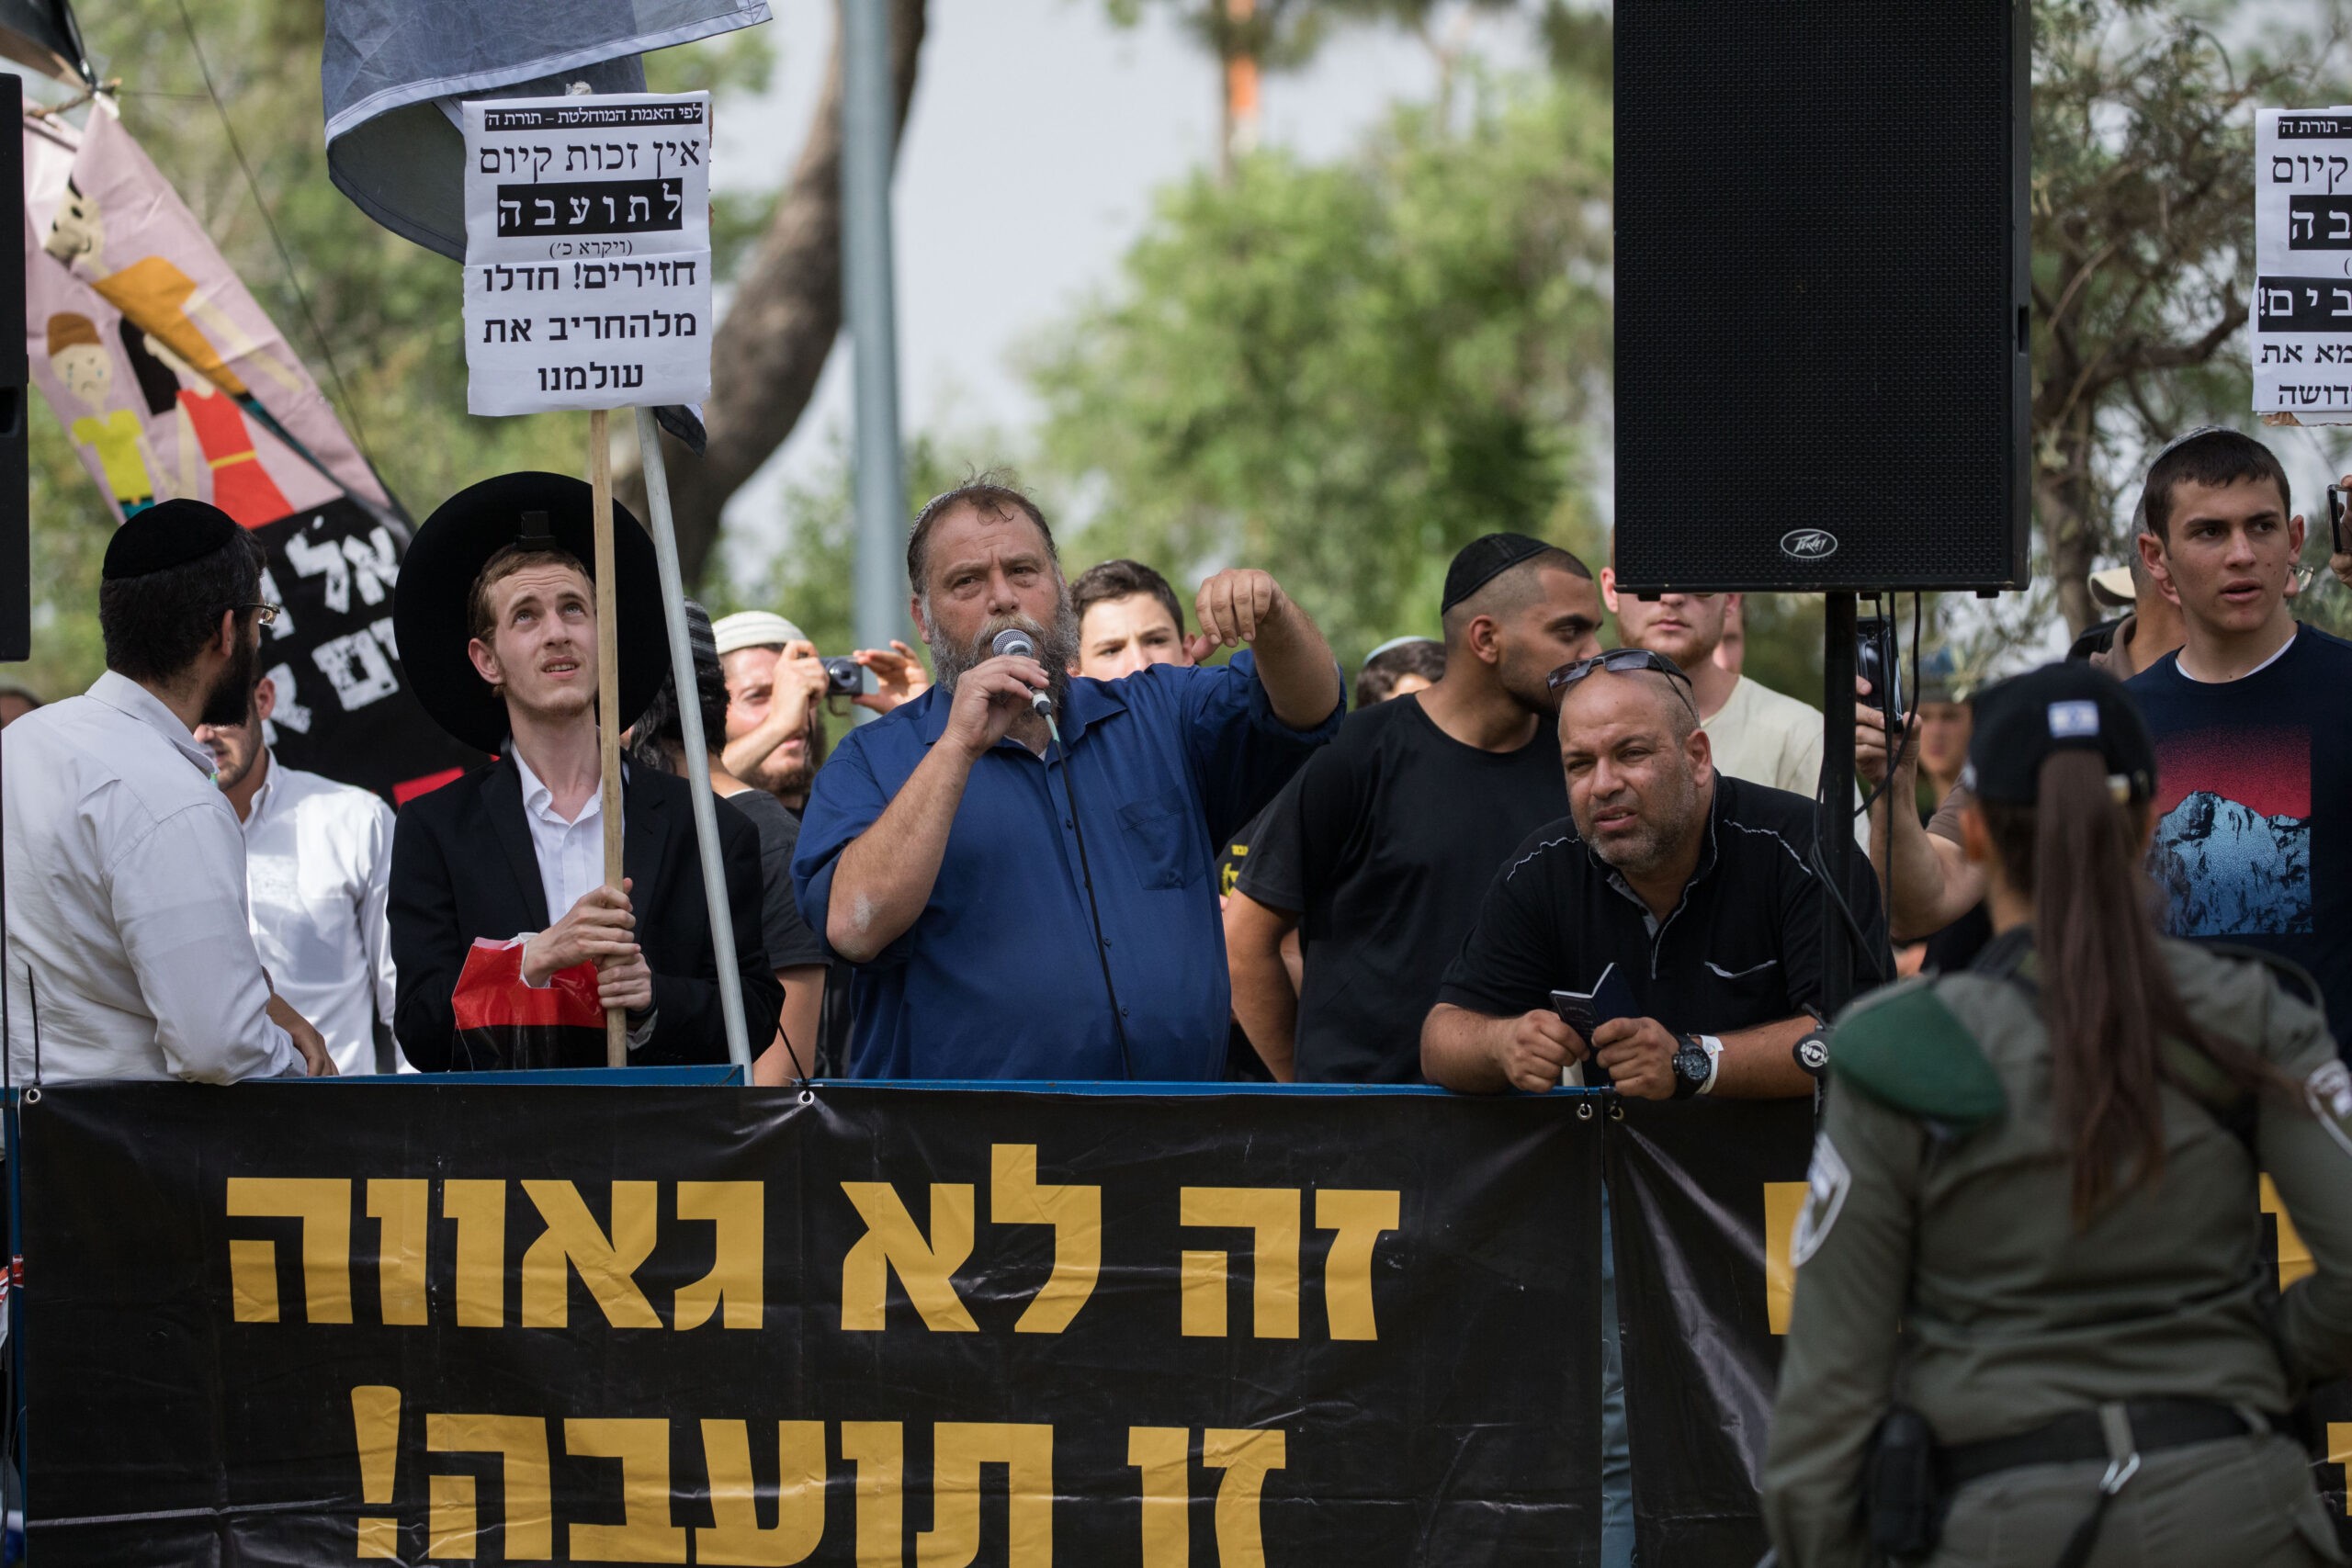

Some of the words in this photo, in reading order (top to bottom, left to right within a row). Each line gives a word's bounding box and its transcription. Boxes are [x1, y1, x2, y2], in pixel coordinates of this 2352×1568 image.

[503, 112, 542, 126] תורת
[558, 107, 627, 124] המוחלטת
[630, 108, 674, 122] האמת
[678, 103, 702, 118] לפי
[2298, 120, 2338, 133] תורת
[480, 145, 552, 183] קיום
[565, 141, 639, 171] זכות
[653, 140, 700, 178] אין
[2272, 154, 2348, 195] קיום
[499, 183, 682, 228] לתועבה
[579, 240, 633, 259] (ויקרא
[483, 264, 560, 292] חדלו
[574, 260, 696, 290] חזירים!
[483, 318, 532, 344] את
[548, 310, 696, 341] מלהחריב
[2261, 344, 2303, 364] את
[537, 361, 643, 391] עולמנו
[2278, 384, 2352, 405] דושה
[840, 1143, 1102, 1334] לא
[226, 1177, 764, 1331] גאווה
[1180, 1186, 1401, 1341] זה
[351, 1385, 1054, 1568] תועבה!
[1127, 1426, 1286, 1568] זו
